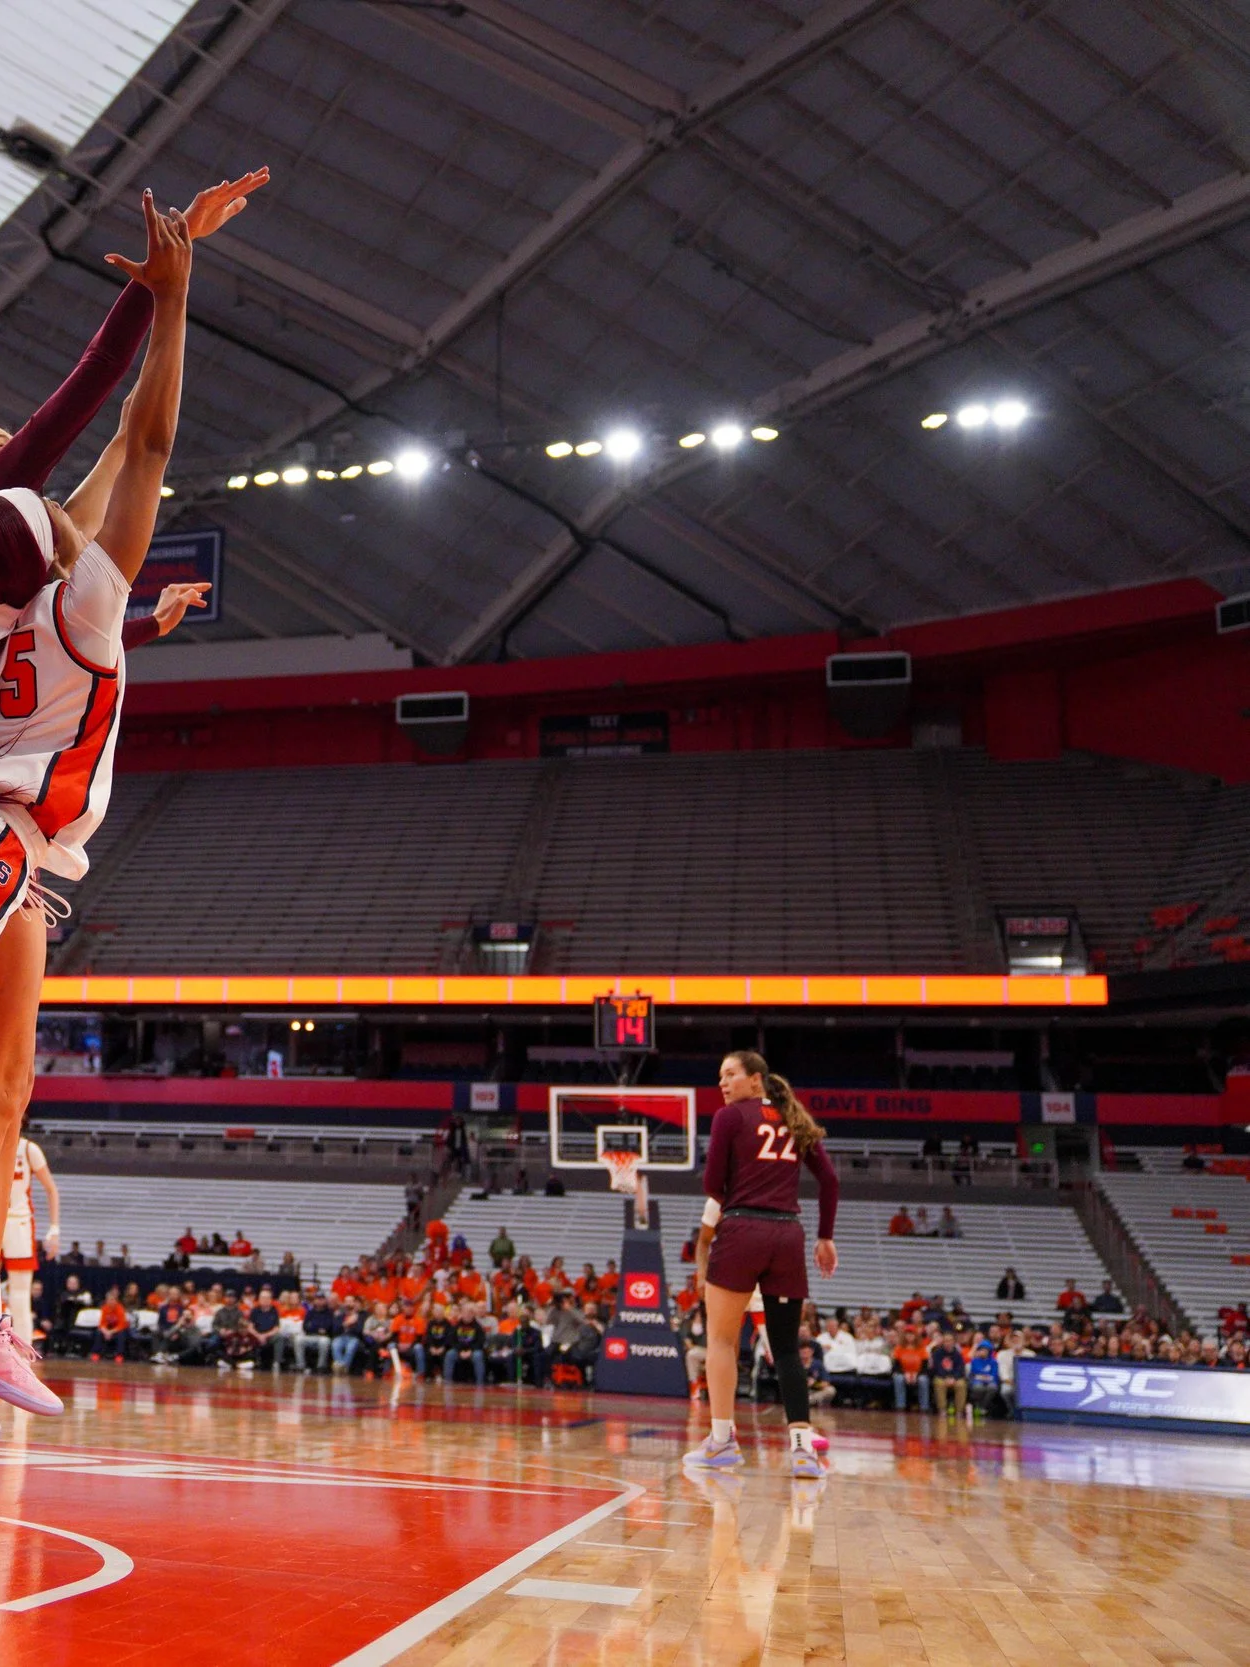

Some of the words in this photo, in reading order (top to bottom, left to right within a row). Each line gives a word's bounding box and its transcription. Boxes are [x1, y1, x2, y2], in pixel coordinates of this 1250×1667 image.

[616, 1017, 645, 1044] 14
[757, 1124, 797, 1162] 22
[620, 1311, 666, 1325] TOYOTA
[630, 1344, 679, 1358] TOYOTA
[1036, 1365, 1180, 1408] SRC
